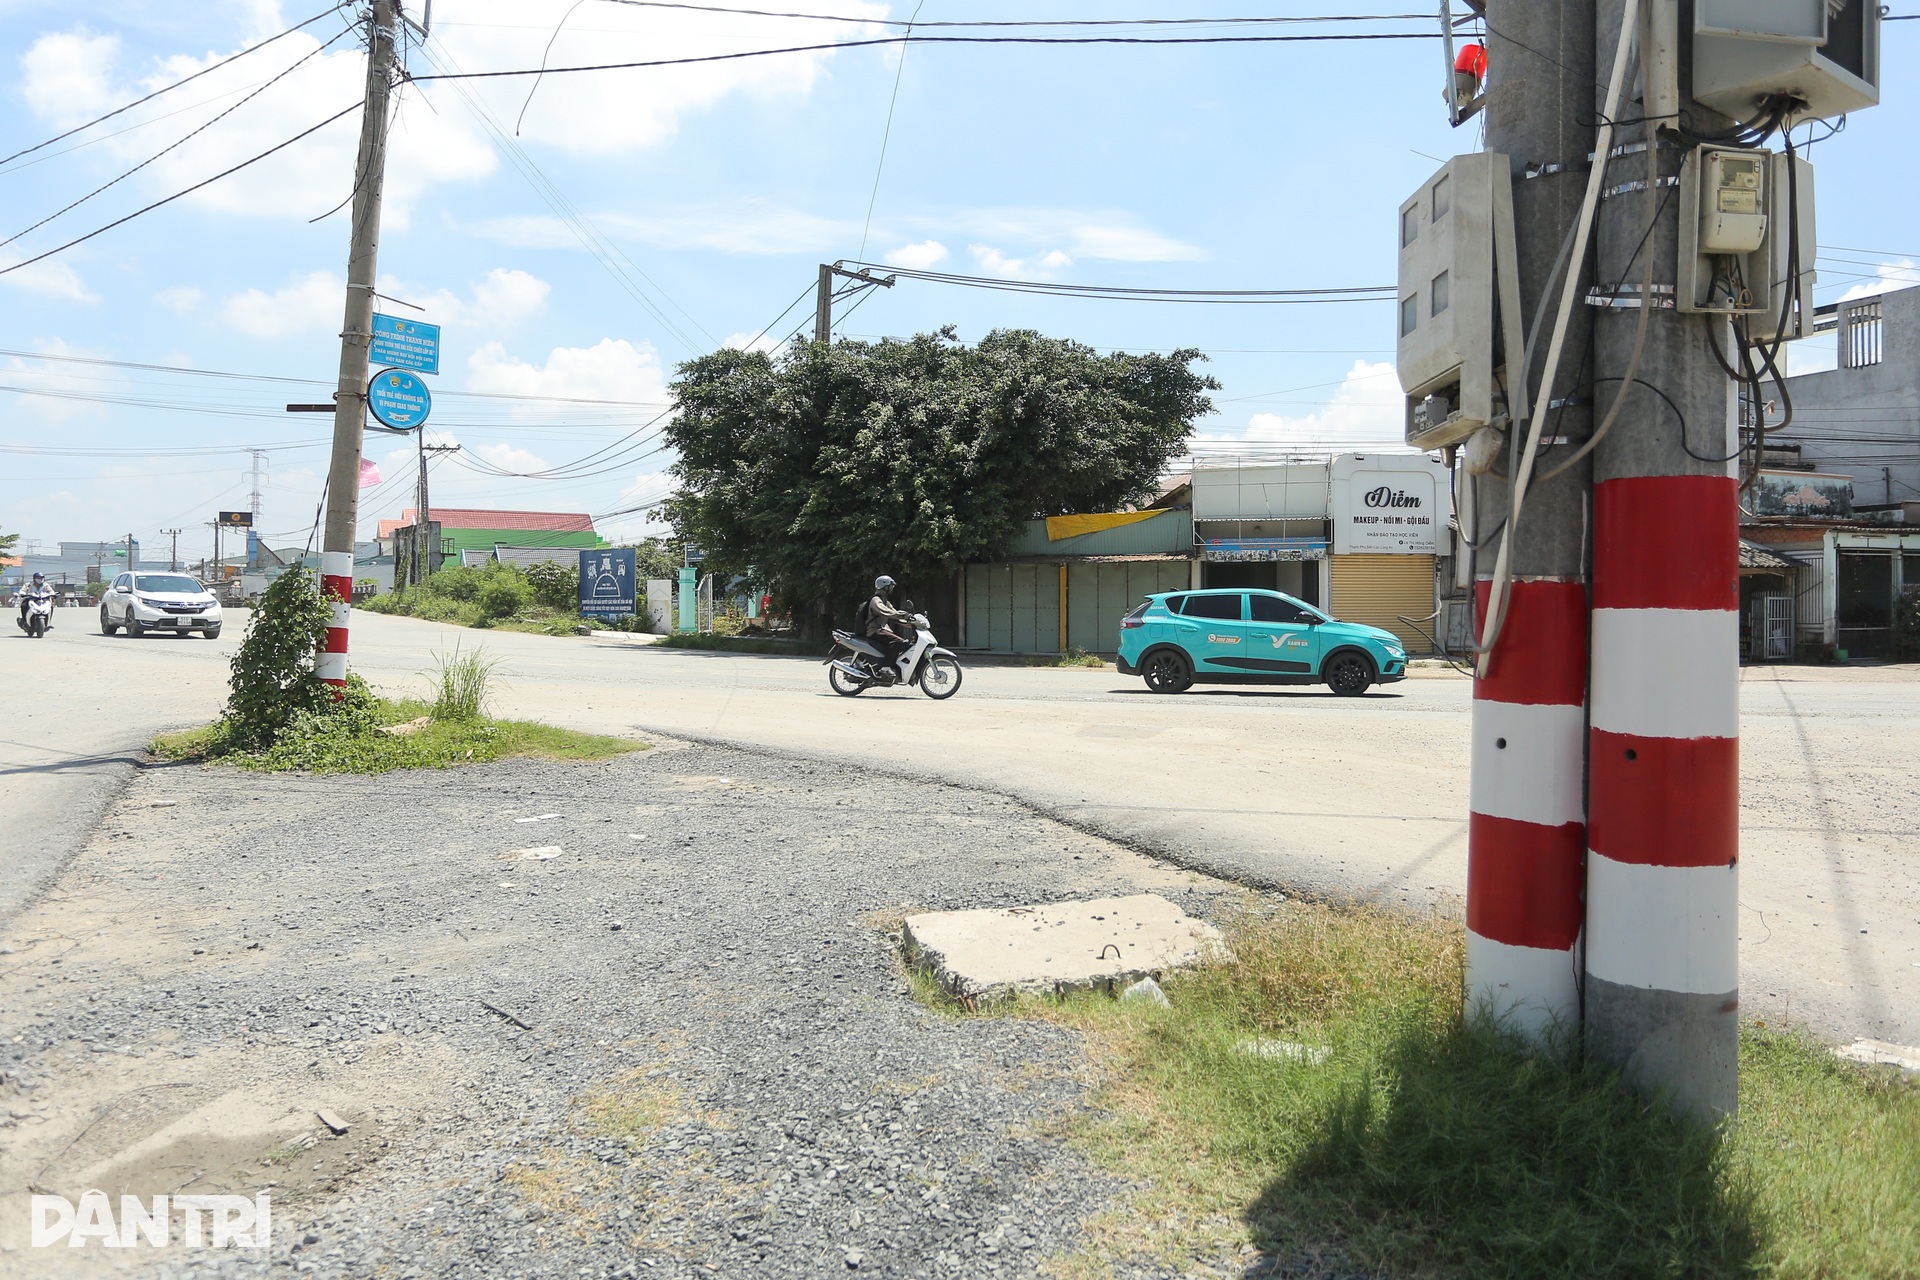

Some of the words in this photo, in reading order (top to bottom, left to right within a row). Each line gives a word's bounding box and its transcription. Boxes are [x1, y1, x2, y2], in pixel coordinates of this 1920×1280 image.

[375, 330, 390, 338] CÔNG
[391, 332, 405, 341] TRÌNH
[406, 336, 422, 344] THANH
[423, 338, 434, 347] NIÊN
[1364, 486, 1422, 508] Diễm
